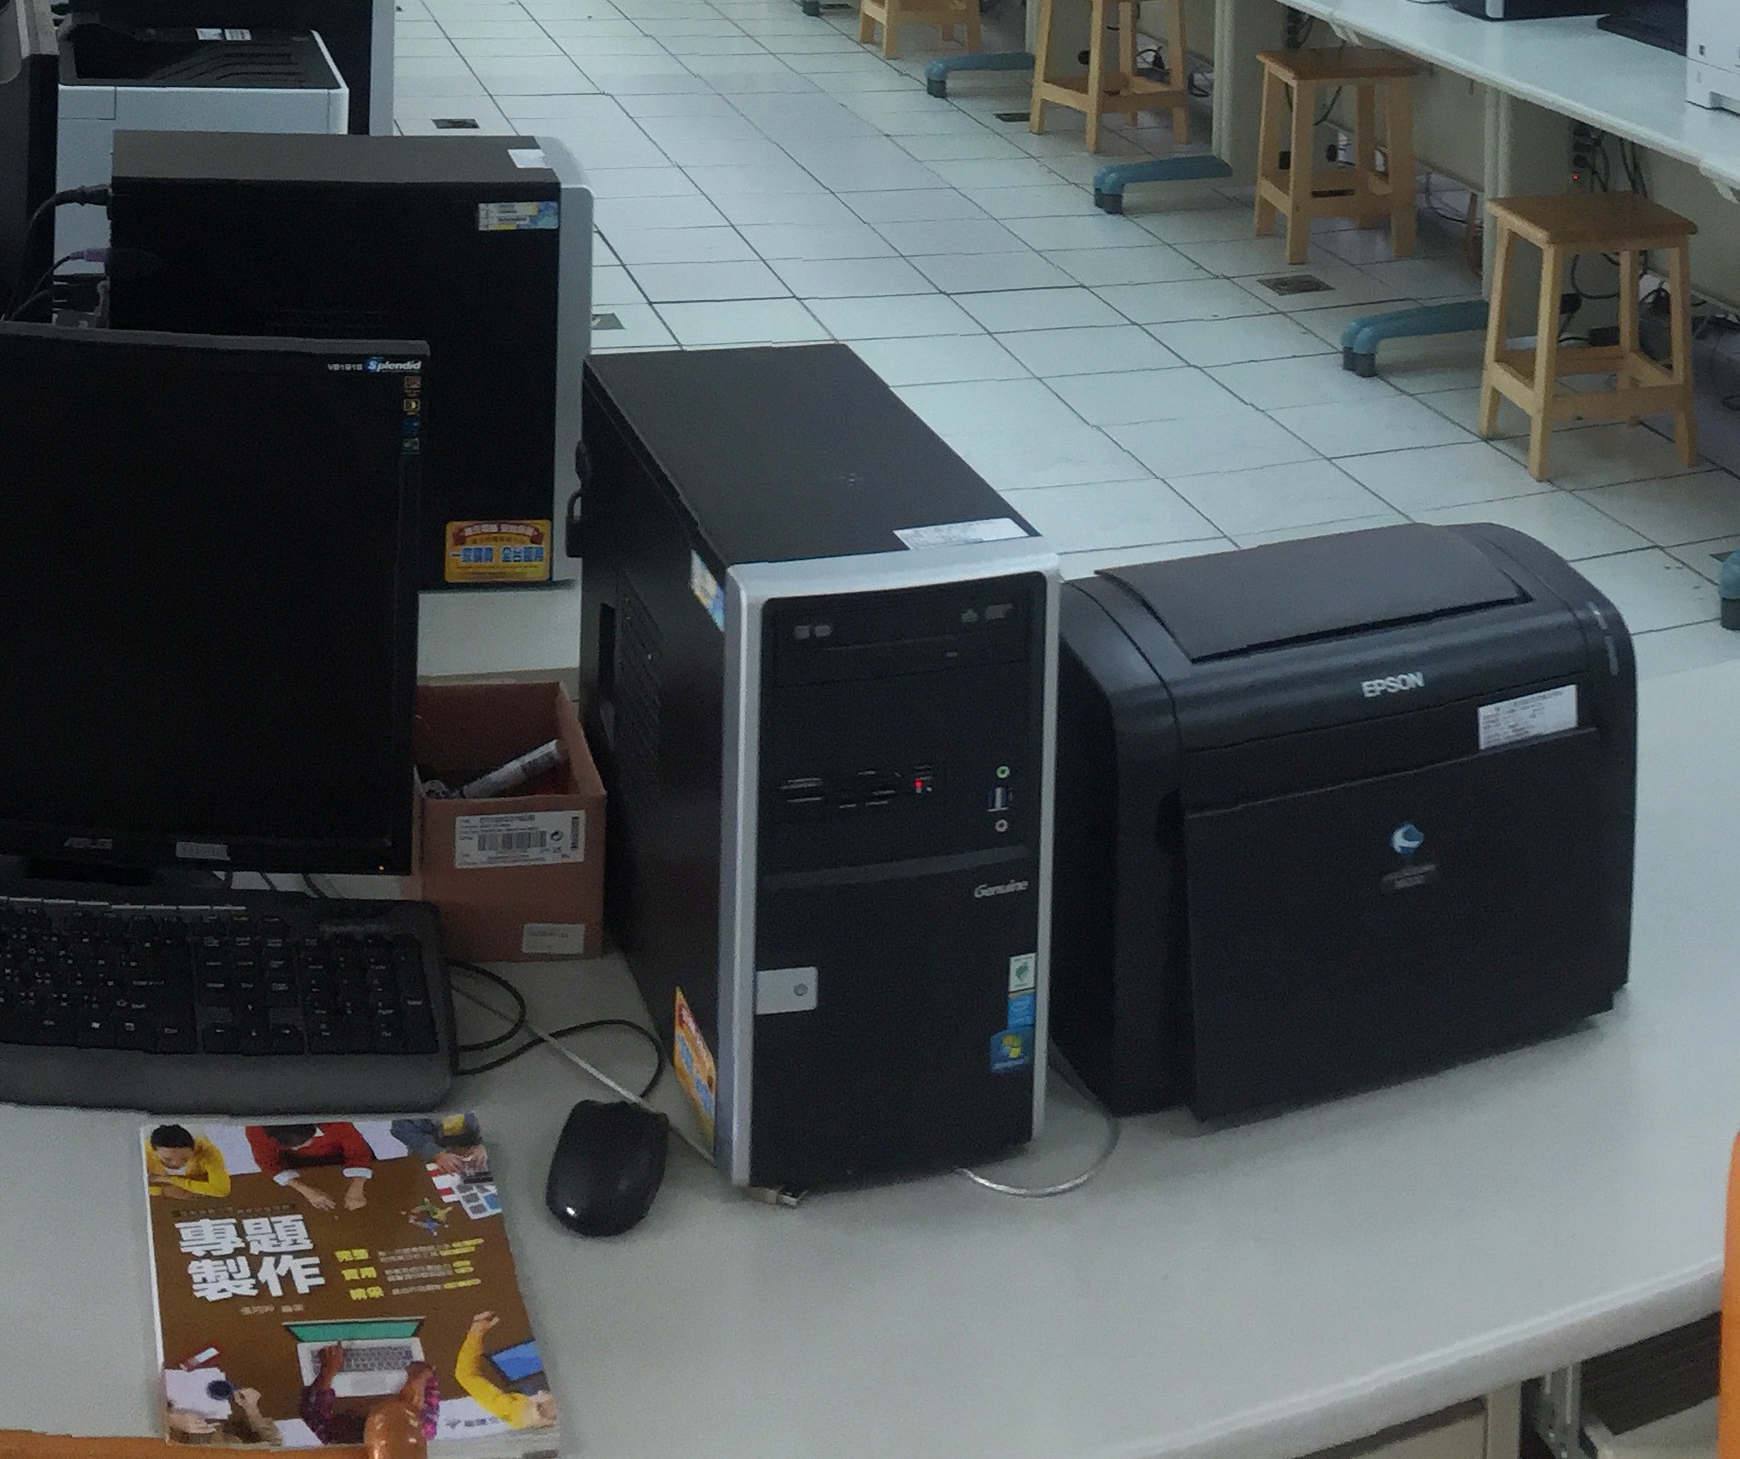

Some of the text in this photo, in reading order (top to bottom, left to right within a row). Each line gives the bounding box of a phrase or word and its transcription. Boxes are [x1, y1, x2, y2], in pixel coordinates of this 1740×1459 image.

[368, 360, 423, 373] Splendid
[1361, 671, 1425, 698] EPSON
[174, 1214, 313, 1256] 專題
[187, 1255, 325, 1302] 製作
